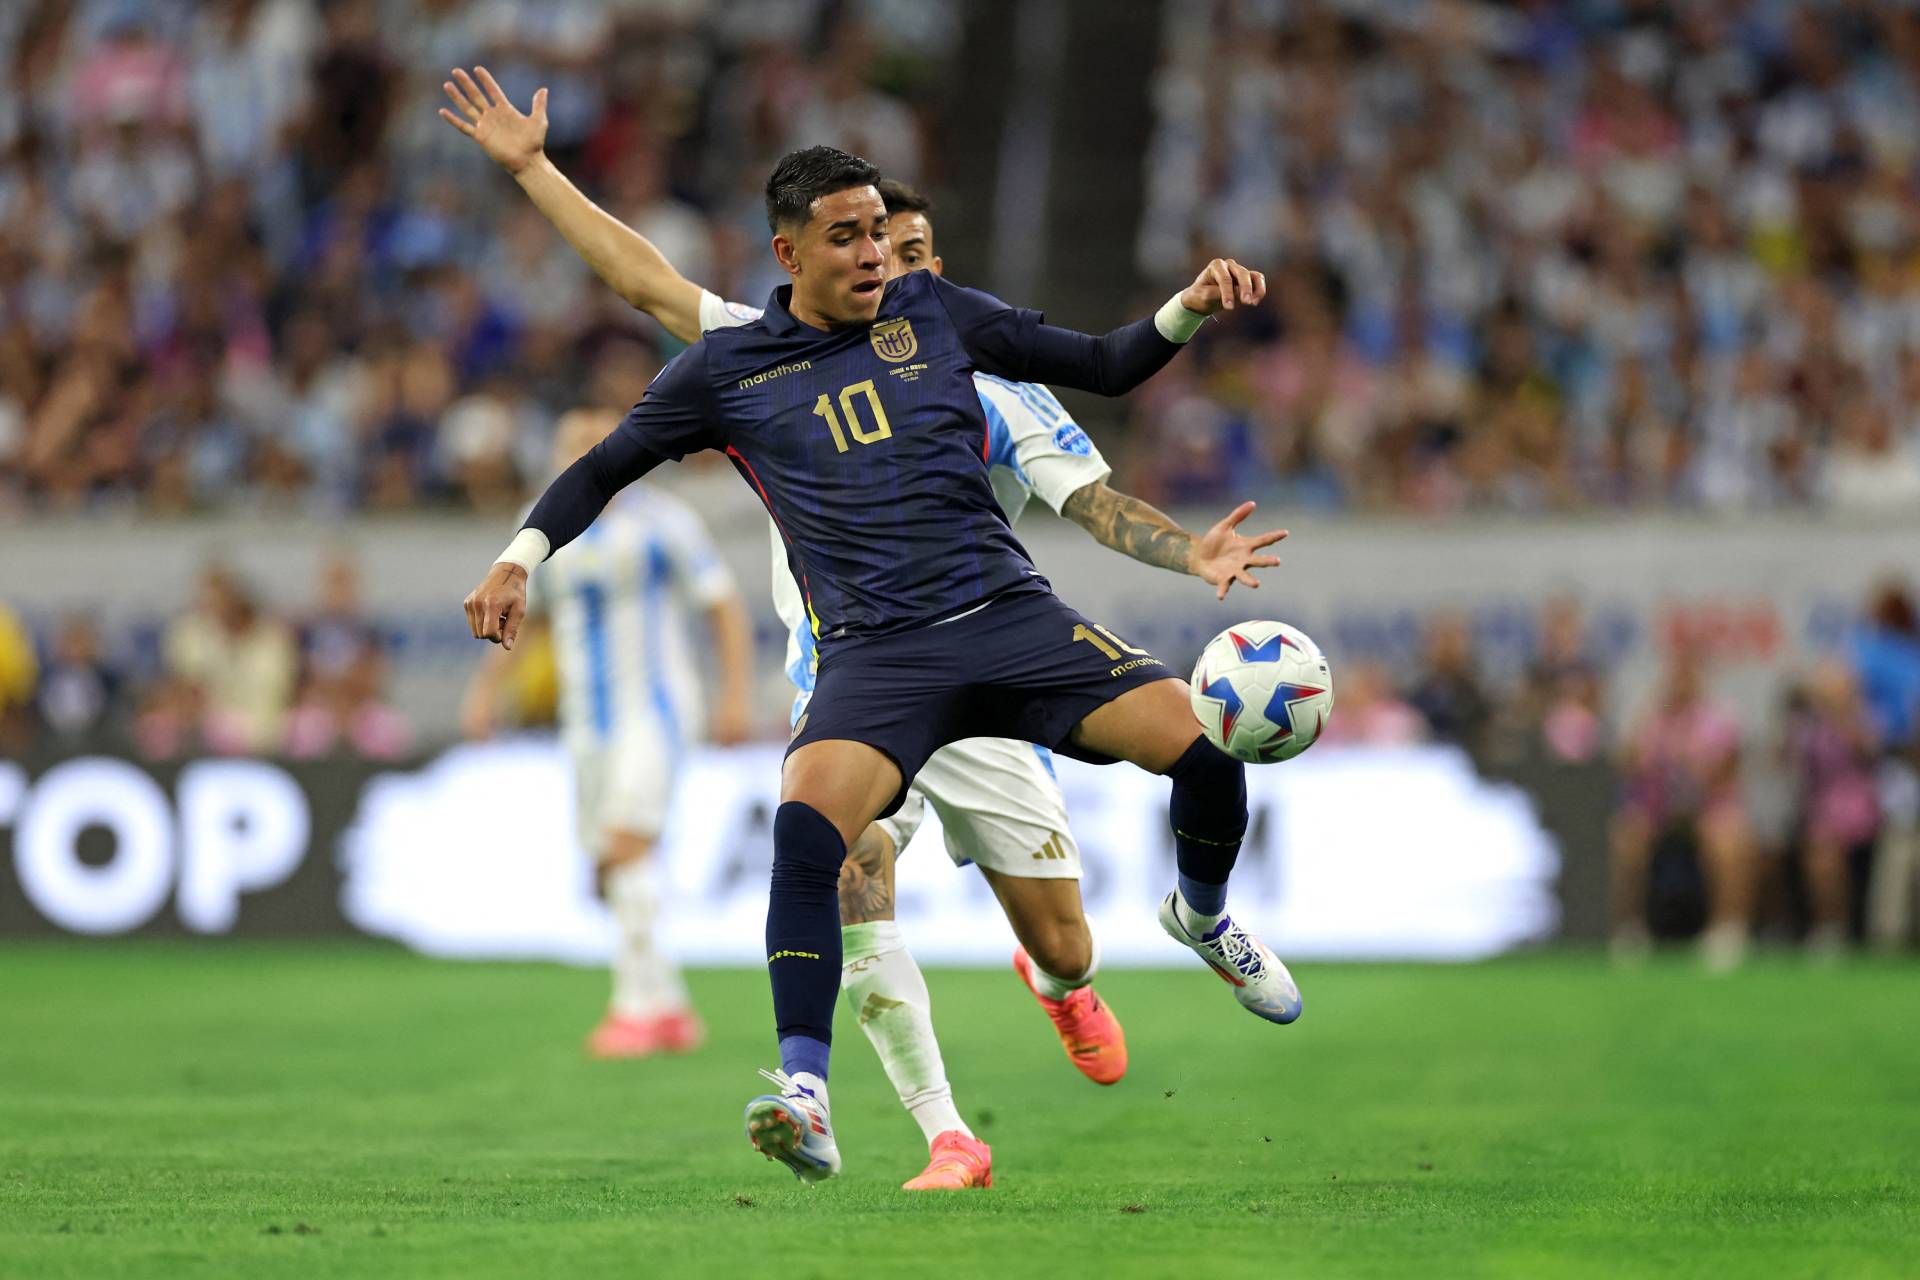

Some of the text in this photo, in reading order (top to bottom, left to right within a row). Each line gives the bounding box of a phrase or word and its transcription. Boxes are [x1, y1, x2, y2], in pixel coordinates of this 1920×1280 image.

[739, 359, 812, 390] marathon
[812, 378, 893, 454] 10
[1110, 657, 1165, 677] marath
